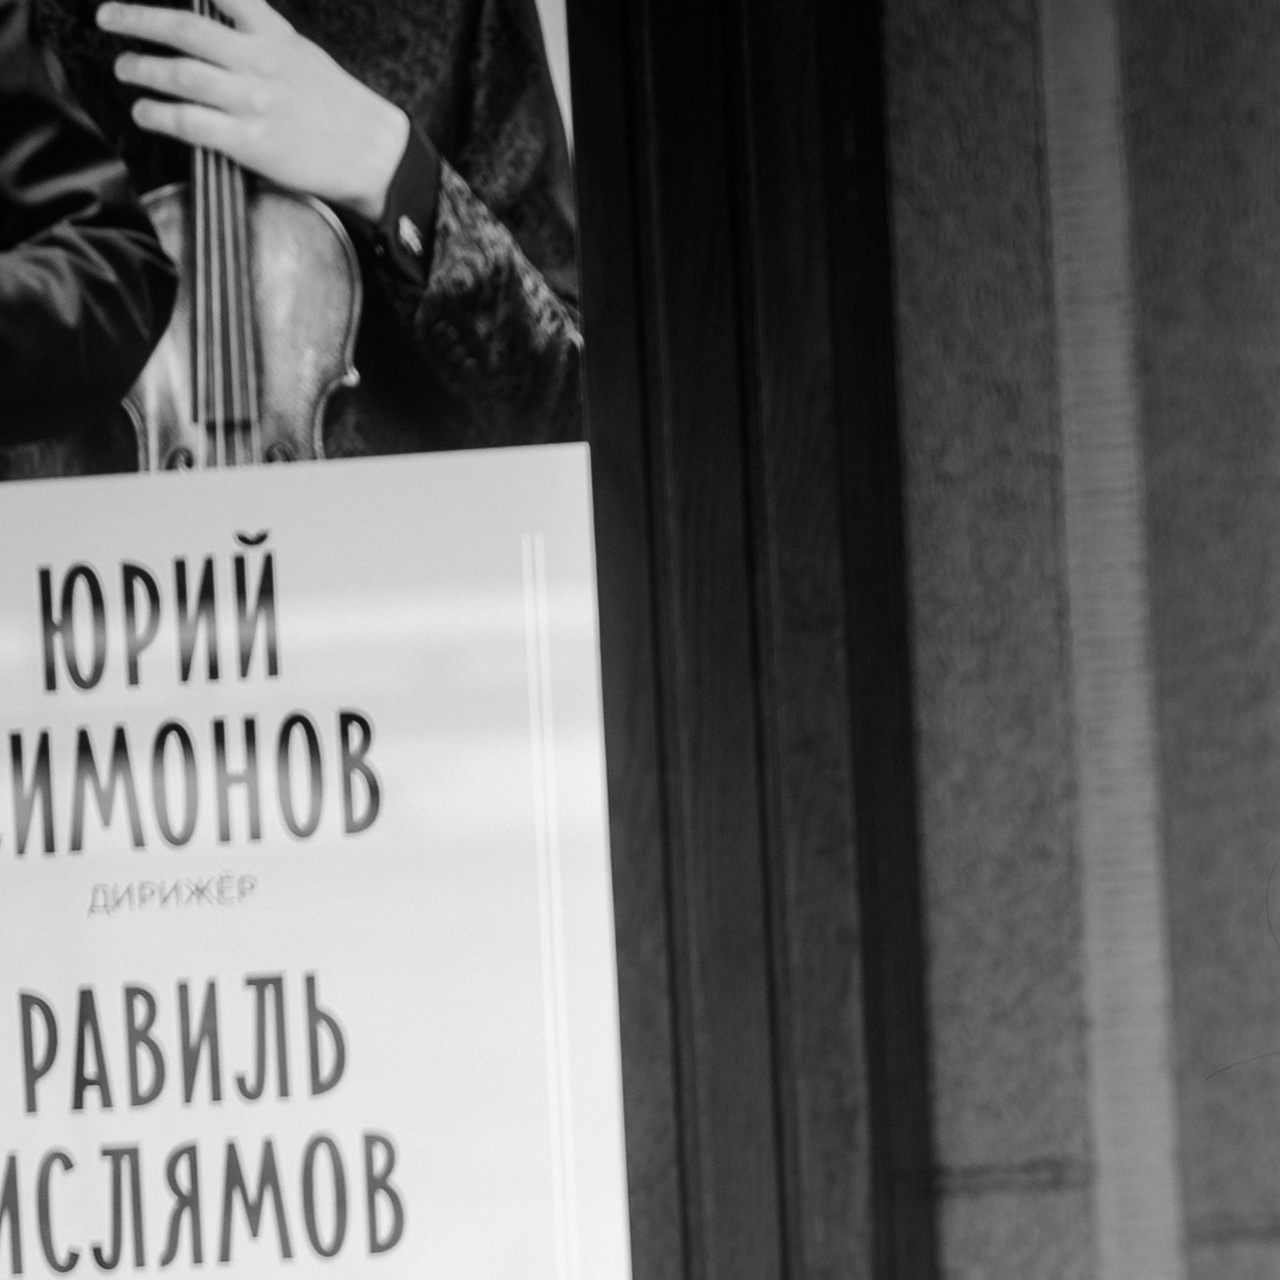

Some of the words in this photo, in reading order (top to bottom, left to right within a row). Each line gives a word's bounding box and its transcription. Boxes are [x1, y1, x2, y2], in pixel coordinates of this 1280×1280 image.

[38, 530, 280, 692] ЮРИЙ
[0, 709, 381, 856] ИМОНОВ
[88, 872, 258, 917] ДИРИЖЁР
[19, 972, 347, 1114] РАВИЛЬ
